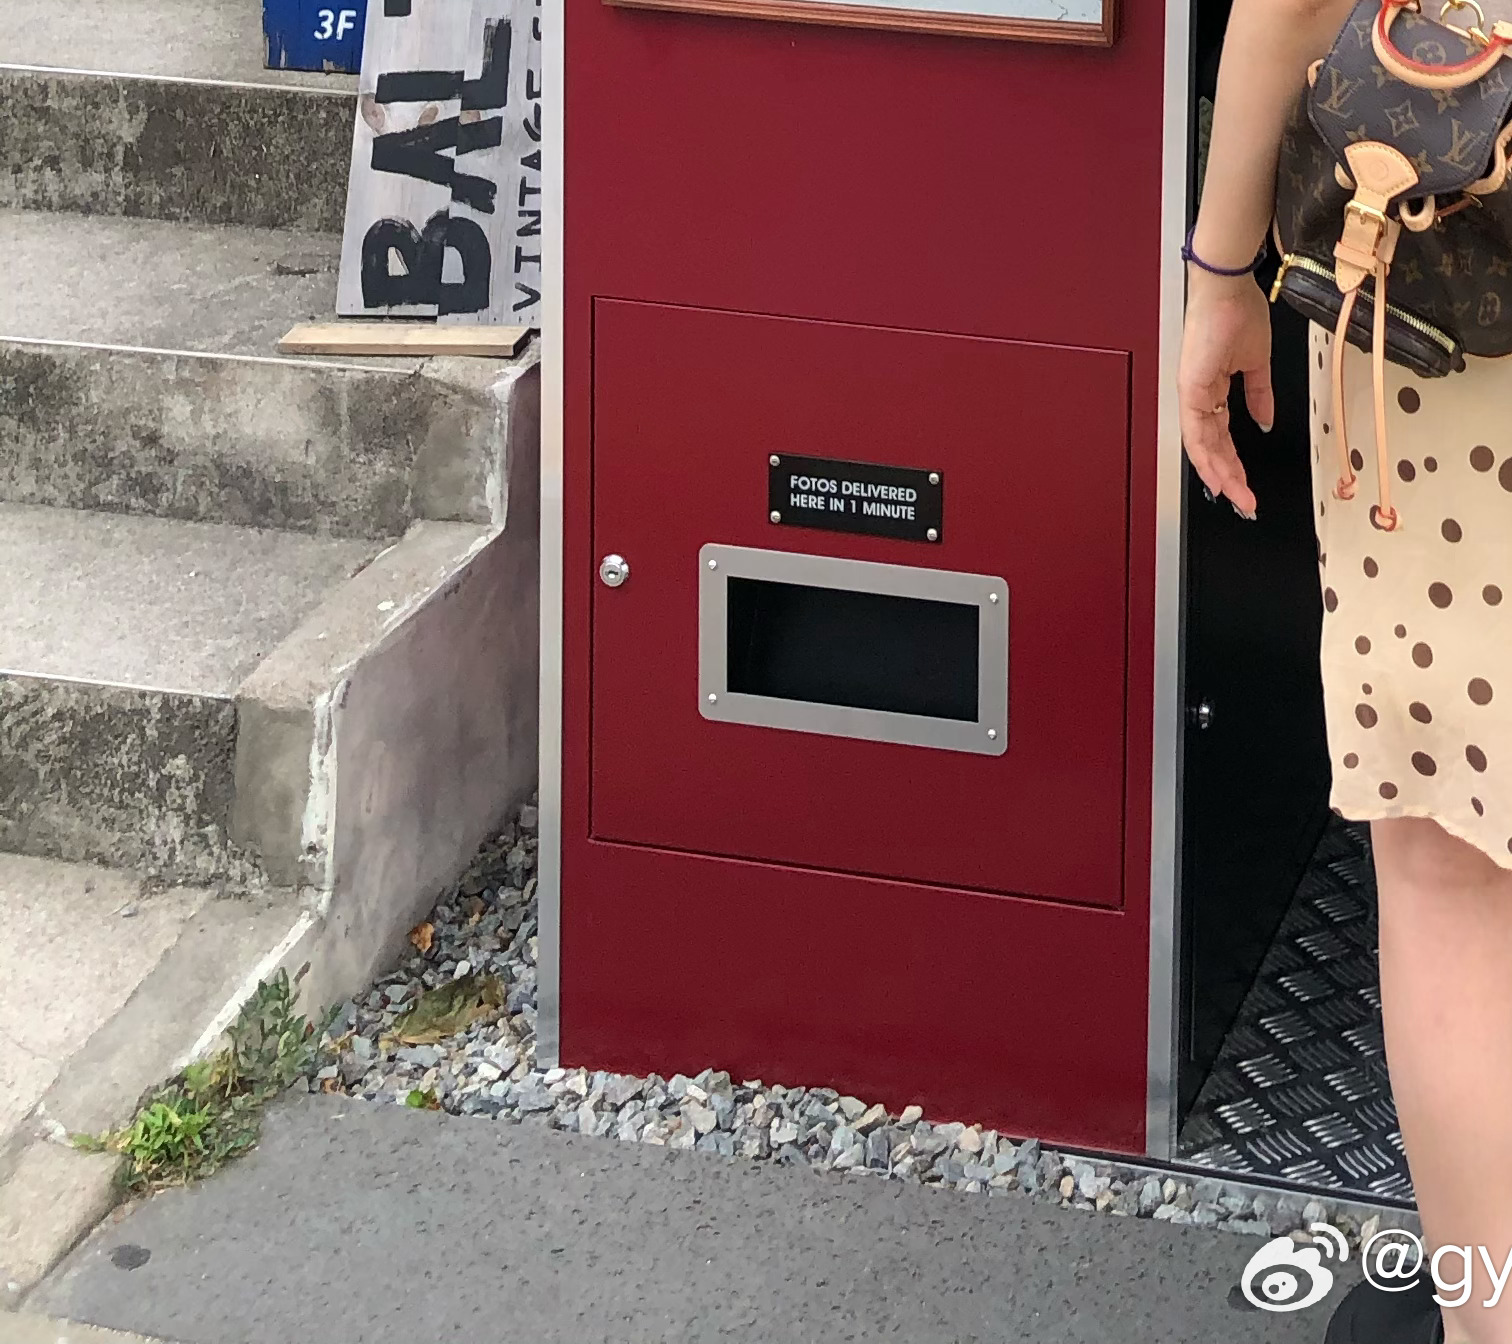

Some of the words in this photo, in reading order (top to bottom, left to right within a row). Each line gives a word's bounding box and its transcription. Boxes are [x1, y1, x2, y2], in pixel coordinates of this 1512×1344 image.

[313, 9, 357, 41] 3F
[790, 475, 838, 493] FOTOS
[841, 480, 917, 502] DELIVERED
[790, 493, 825, 510] HERE
[829, 497, 845, 513] IN
[849, 499, 857, 513] 1
[862, 501, 916, 521] MINUTE
